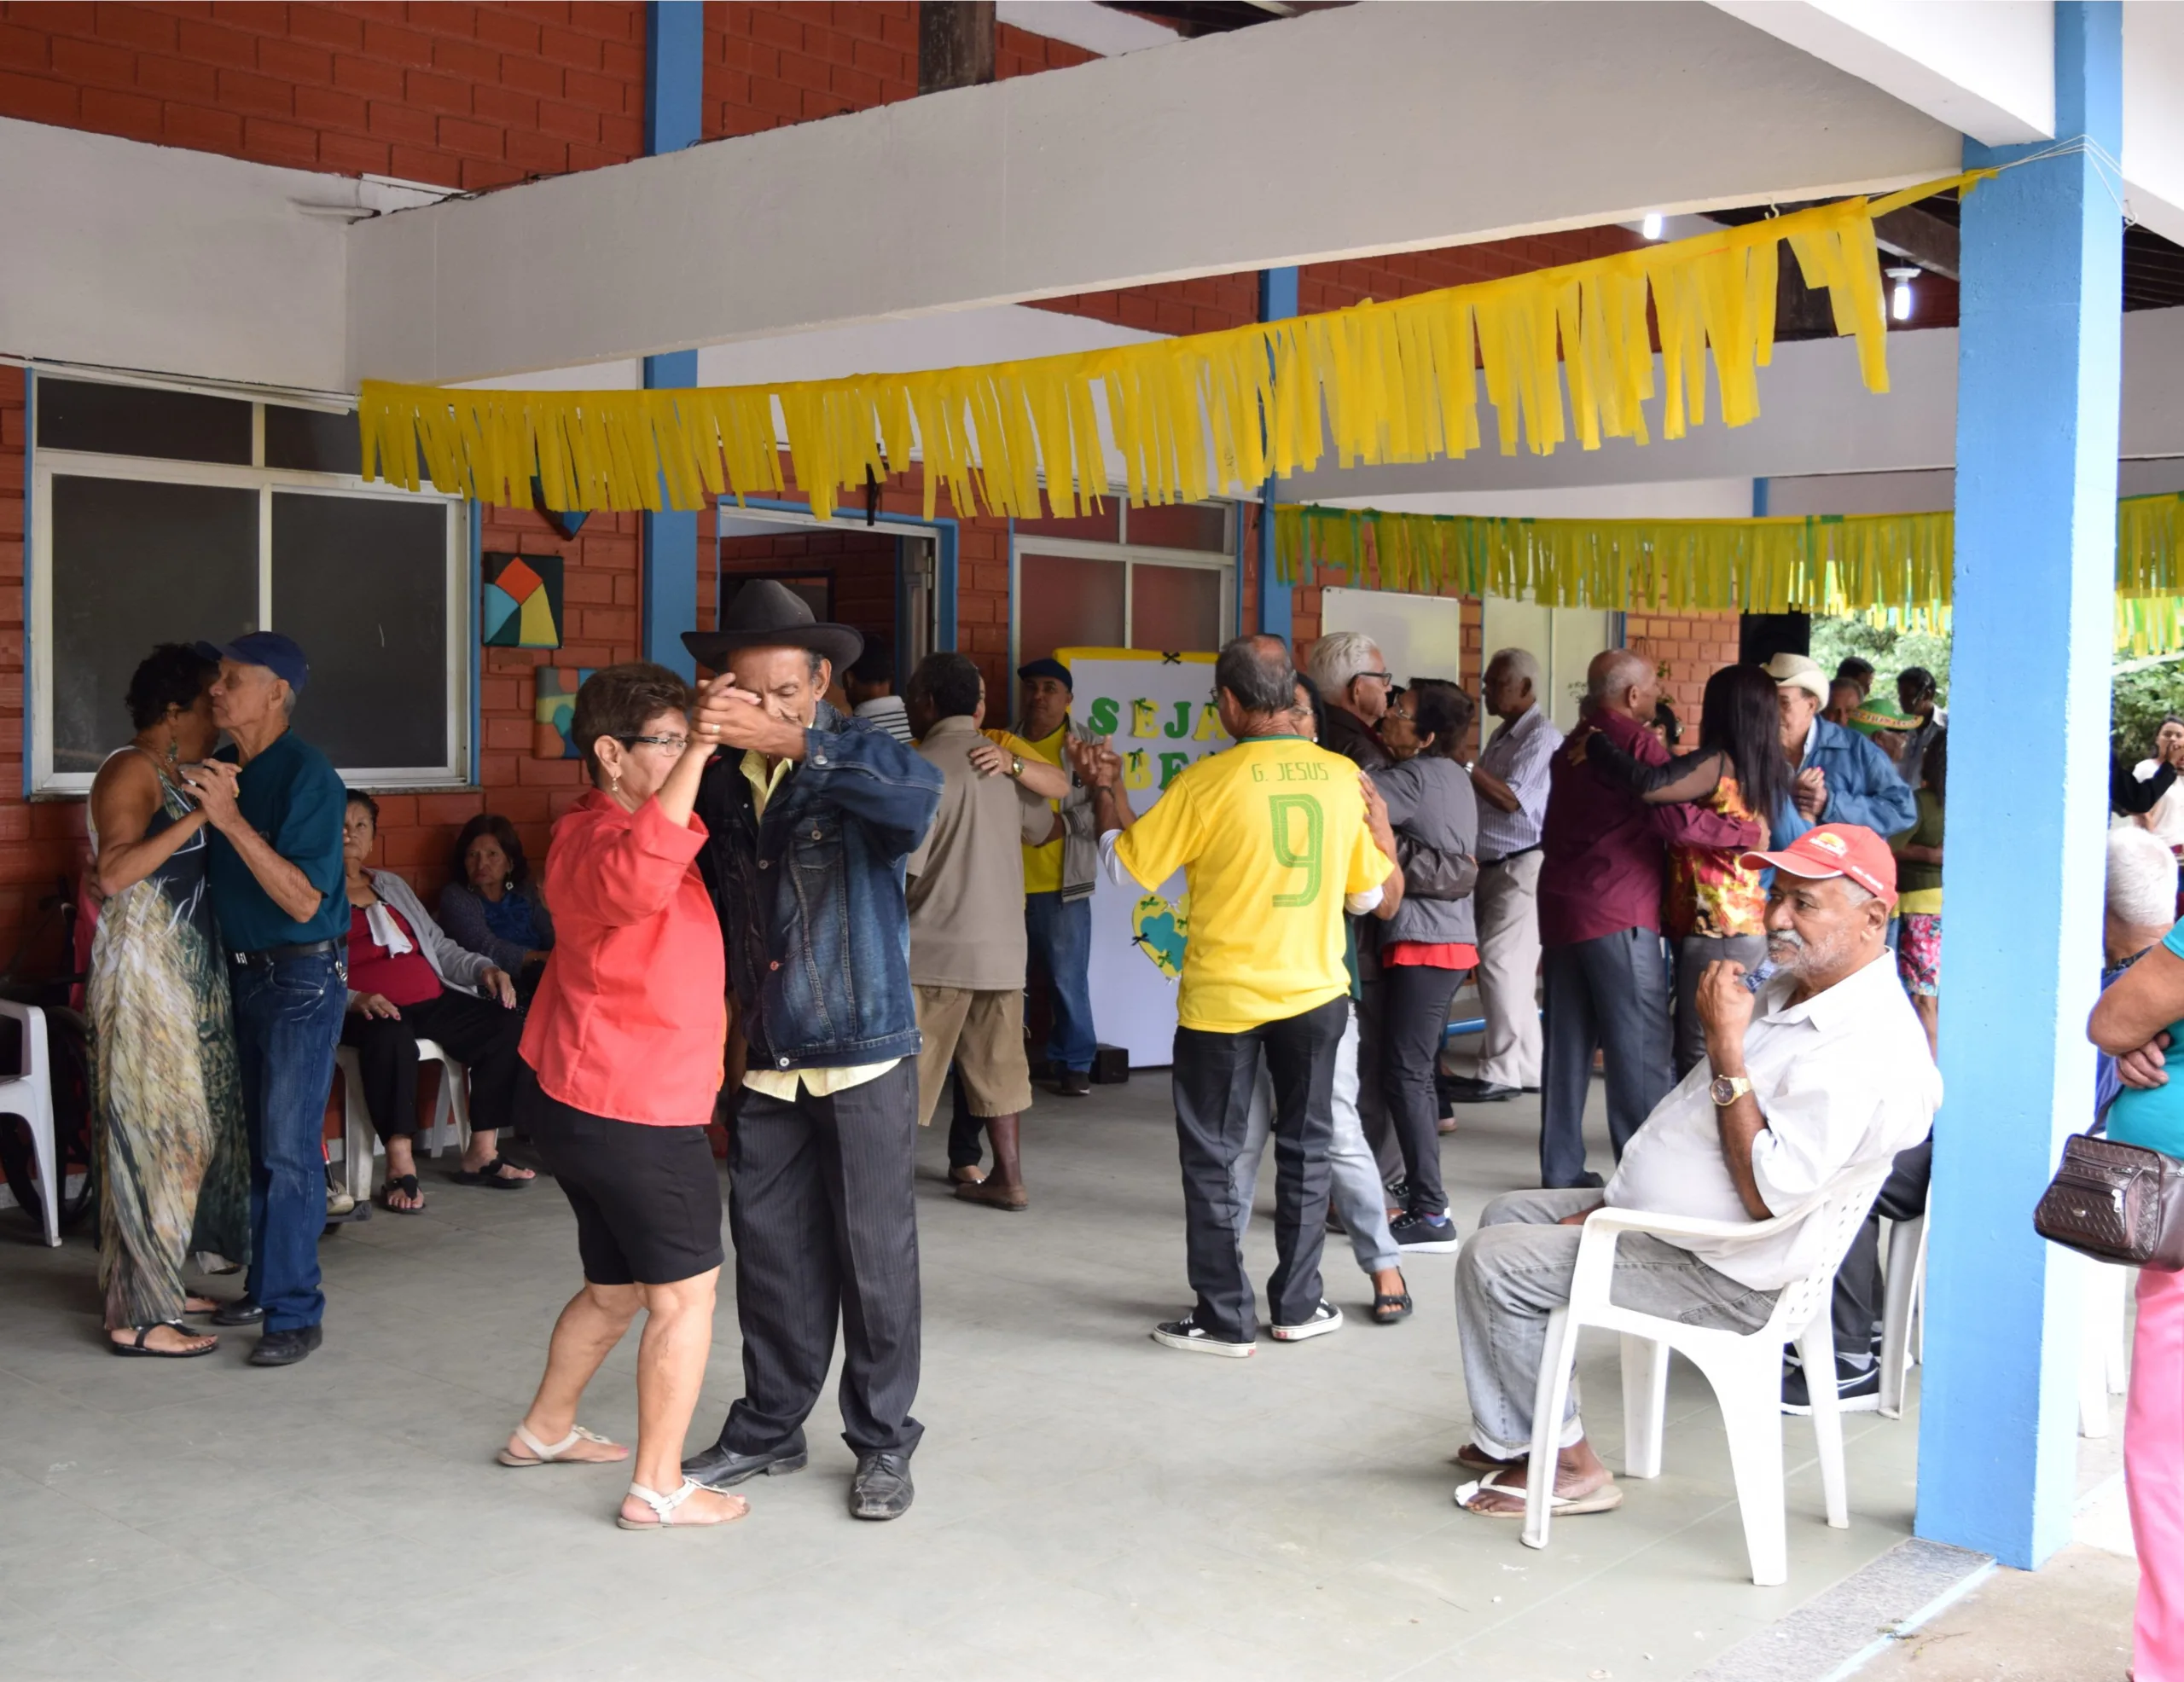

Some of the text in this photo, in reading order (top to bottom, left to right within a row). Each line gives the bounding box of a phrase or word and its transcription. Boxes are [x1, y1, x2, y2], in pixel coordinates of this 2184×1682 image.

[1088, 697, 1228, 741] SEJA
[1122, 751, 1213, 791] BE
[1252, 762, 1329, 782] G. JESUS
[1269, 793, 1324, 908] 9
